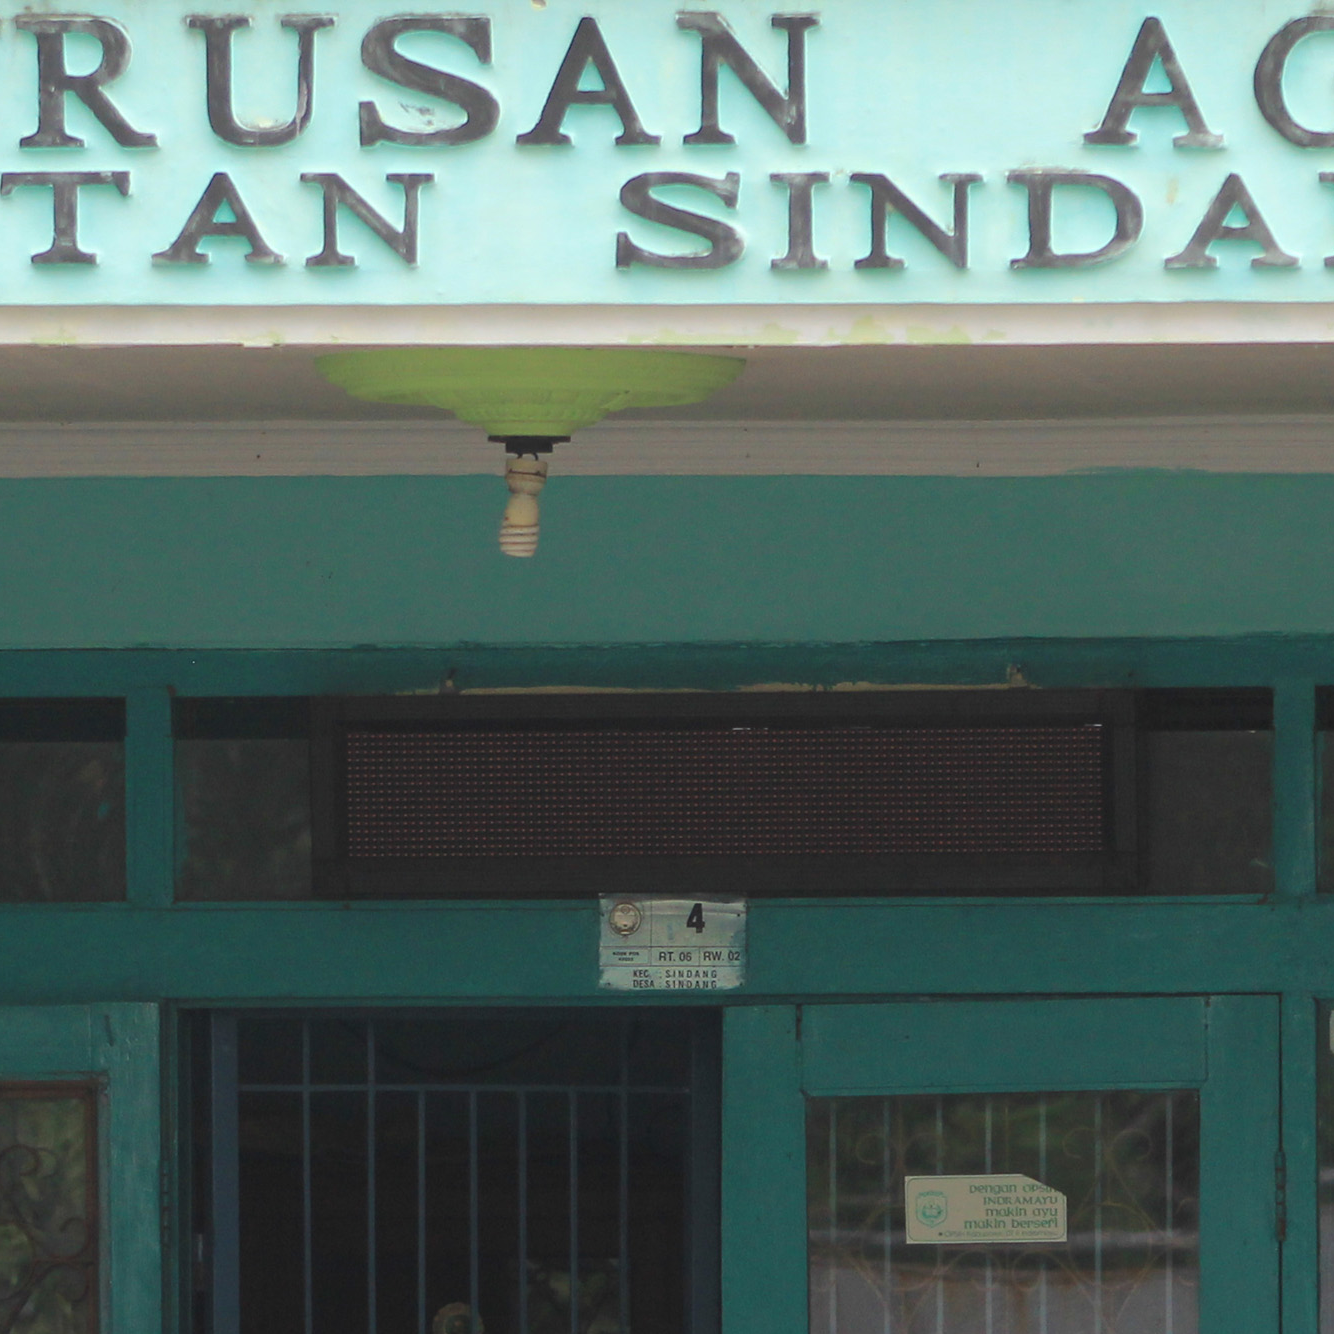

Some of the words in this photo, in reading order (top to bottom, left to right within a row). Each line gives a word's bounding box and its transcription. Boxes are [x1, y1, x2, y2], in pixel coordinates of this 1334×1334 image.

[686, 903, 706, 934] 4
[658, 951, 676, 962] RT.
[679, 951, 692, 962] 06
[703, 951, 725, 962] RW.
[727, 950, 741, 961] 02
[665, 969, 718, 979] SINDANG
[633, 980, 655, 989] DESA
[665, 980, 718, 989] SINDANG
[983, 1195, 1058, 1206] INDRAMAYU
[986, 1206, 1027, 1217] makin
[1032, 1207, 1058, 1219] ayu
[963, 1218, 1006, 1230] makin
